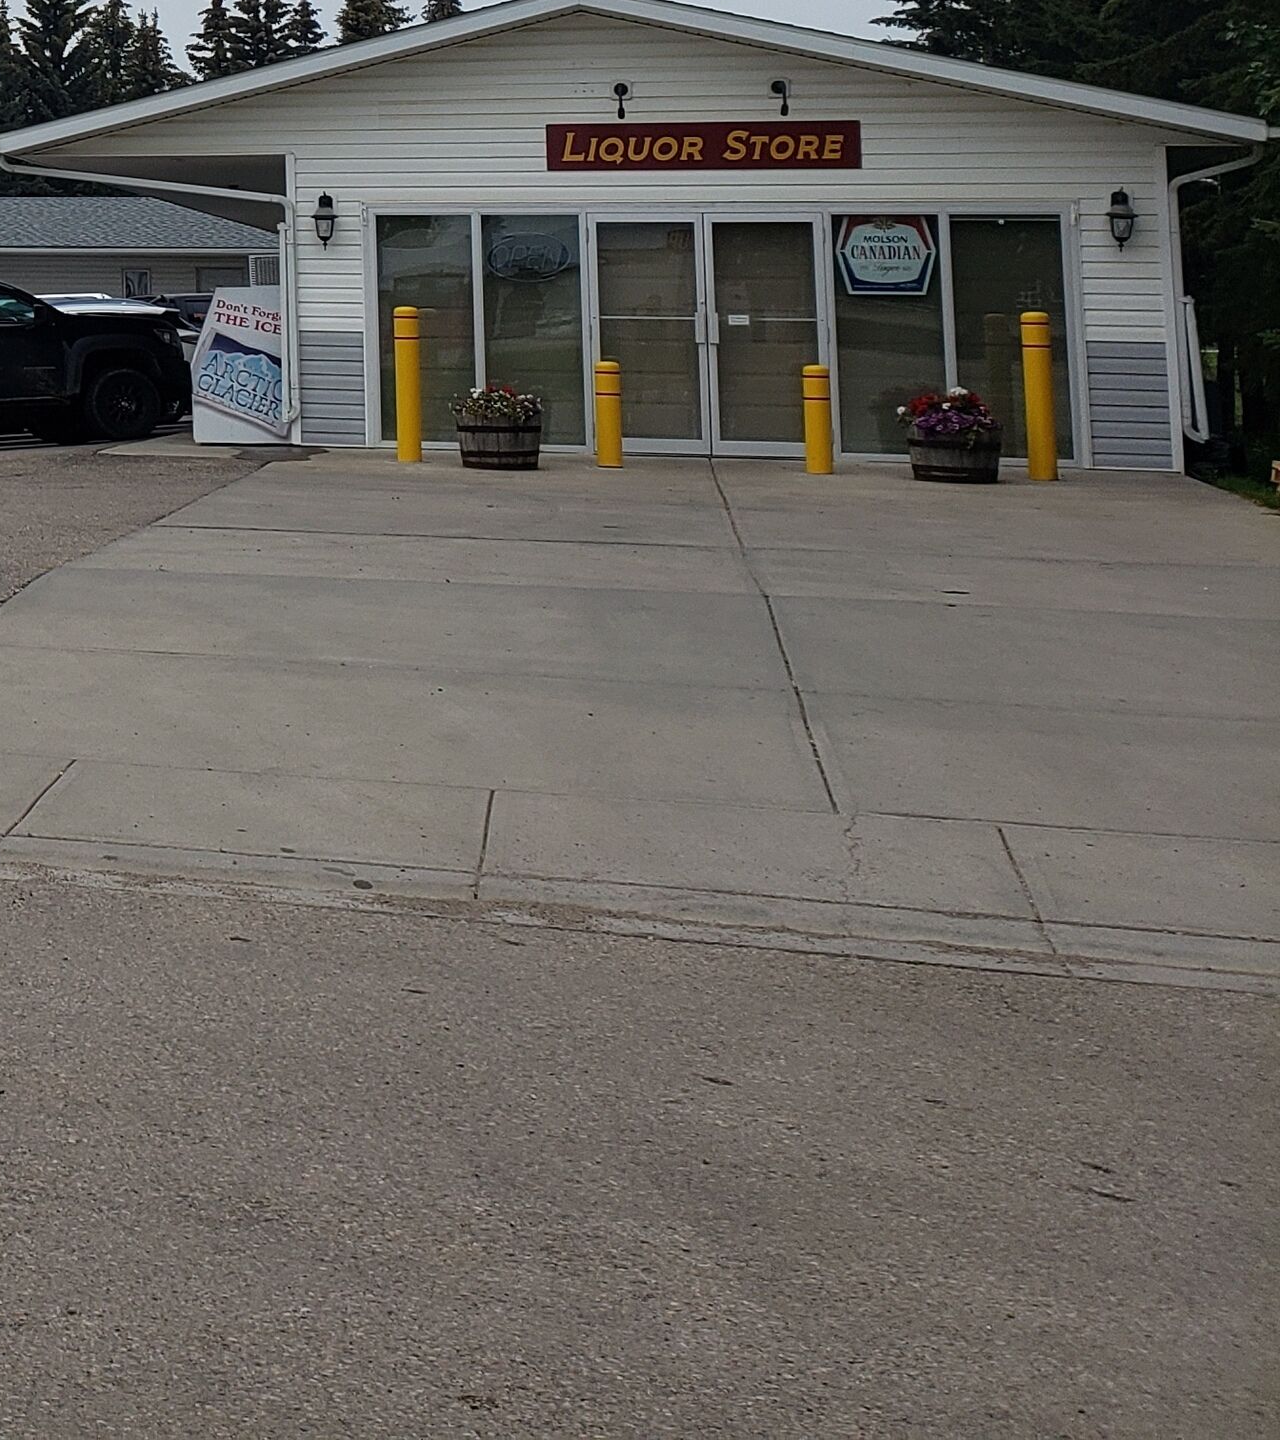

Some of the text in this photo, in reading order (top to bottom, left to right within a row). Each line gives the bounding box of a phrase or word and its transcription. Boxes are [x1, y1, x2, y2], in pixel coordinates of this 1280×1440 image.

[561, 130, 845, 165] LIQUOR STORE
[851, 244, 921, 260] CANADIAN
[863, 235, 909, 244] MOLSON
[490, 245, 562, 270] OPEN
[215, 299, 282, 322] Don't Forg
[214, 311, 282, 336] THE ICE
[197, 373, 280, 421] GLACIER
